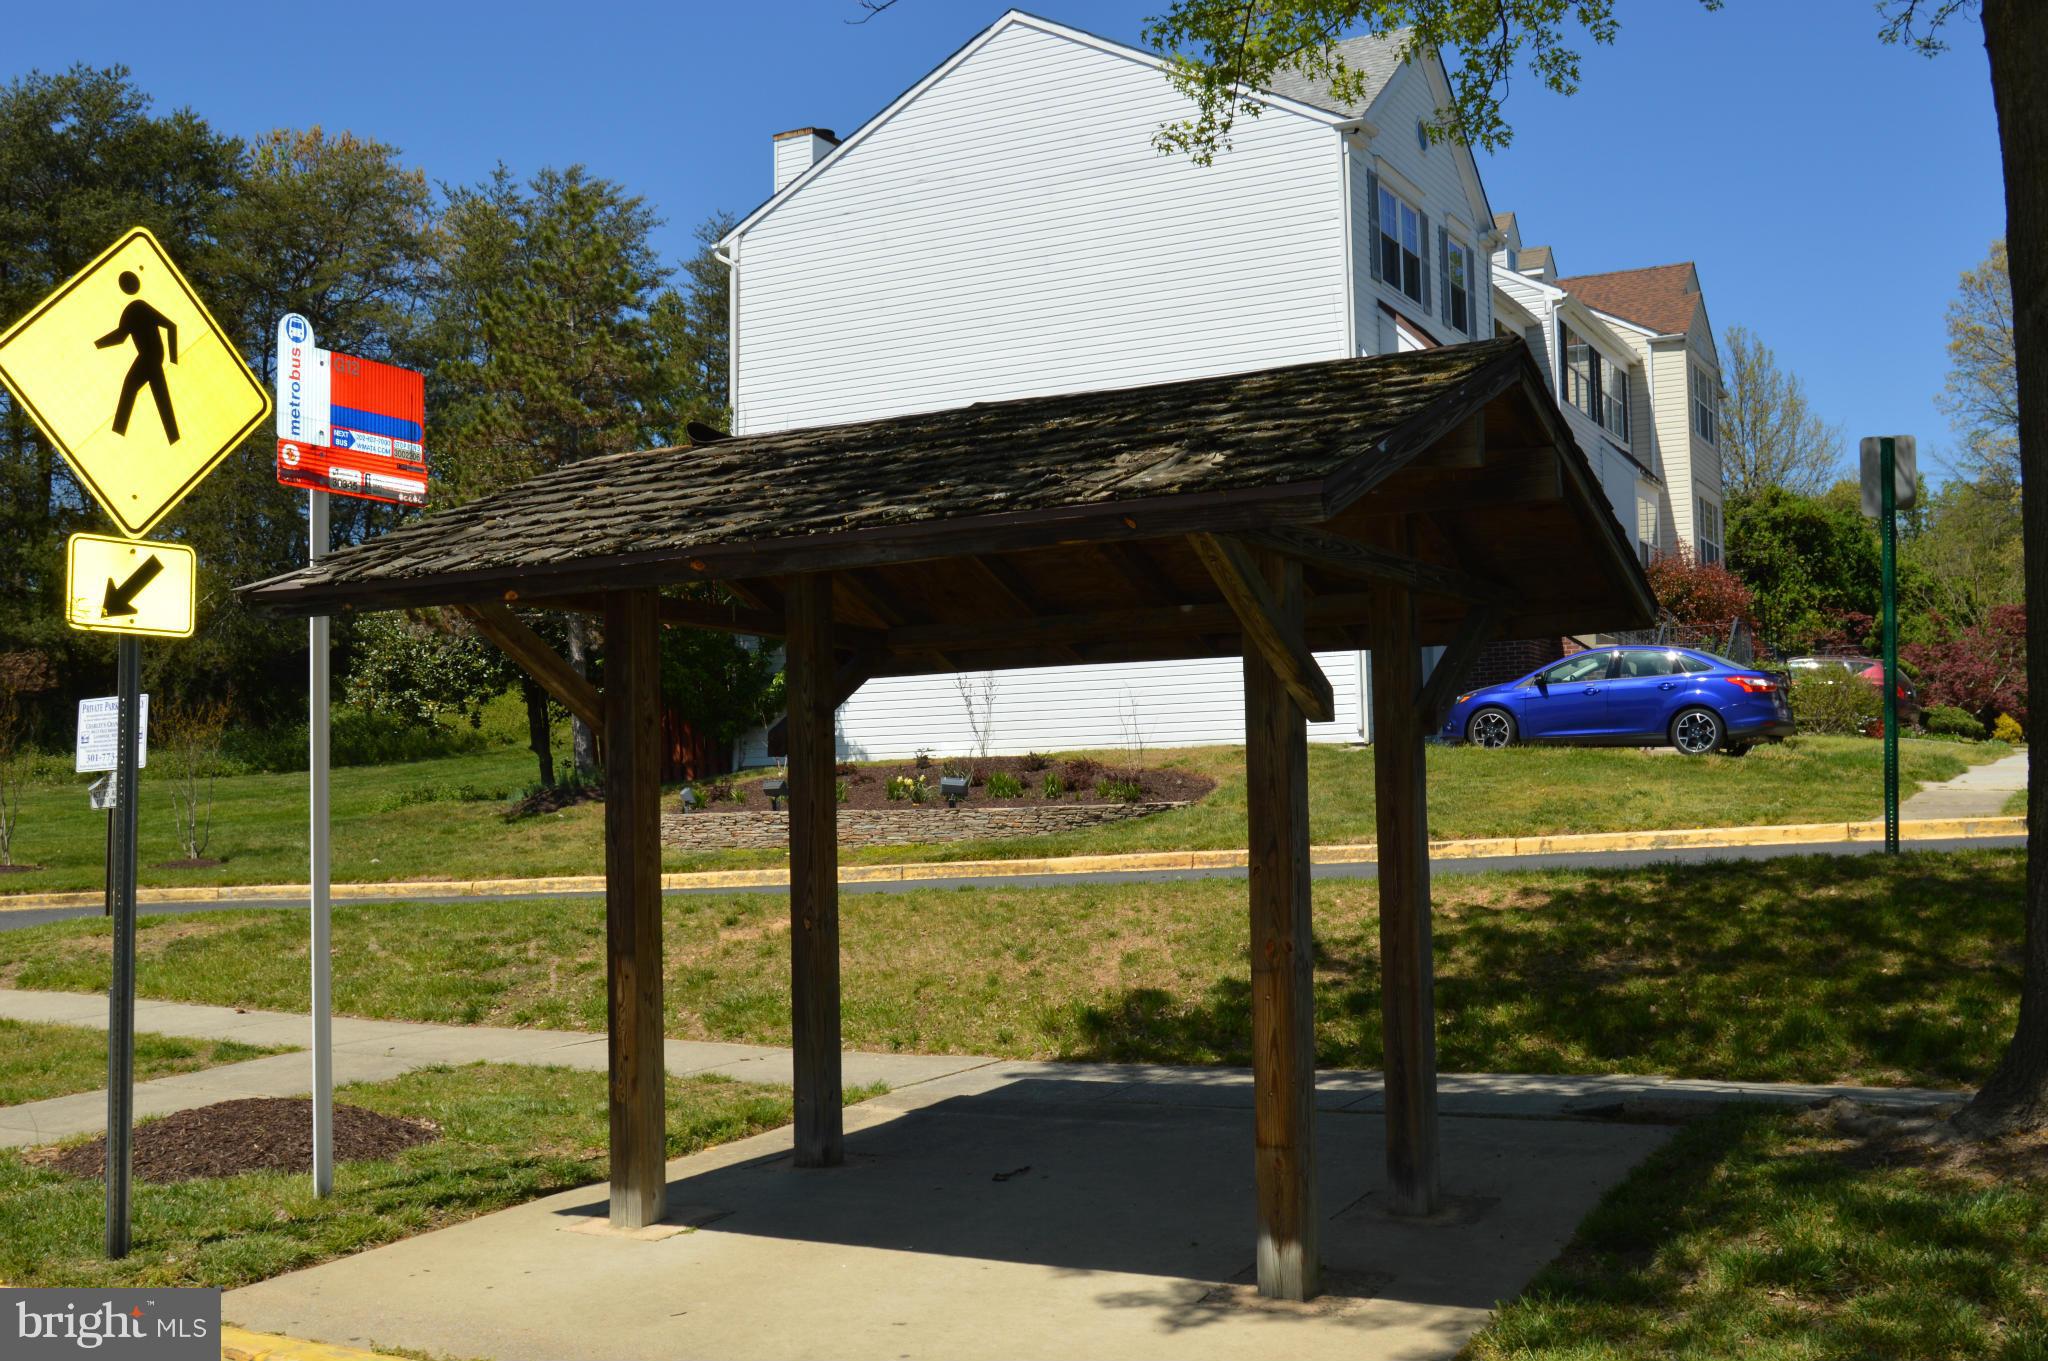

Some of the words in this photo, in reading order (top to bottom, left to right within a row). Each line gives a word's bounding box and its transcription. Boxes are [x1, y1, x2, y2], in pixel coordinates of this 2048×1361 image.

[334, 357, 360, 377] G12
[289, 347, 301, 436] metrobus
[333, 429, 349, 438] NEXT
[335, 438, 348, 447] BUS
[82, 703, 104, 713] PRIVATE
